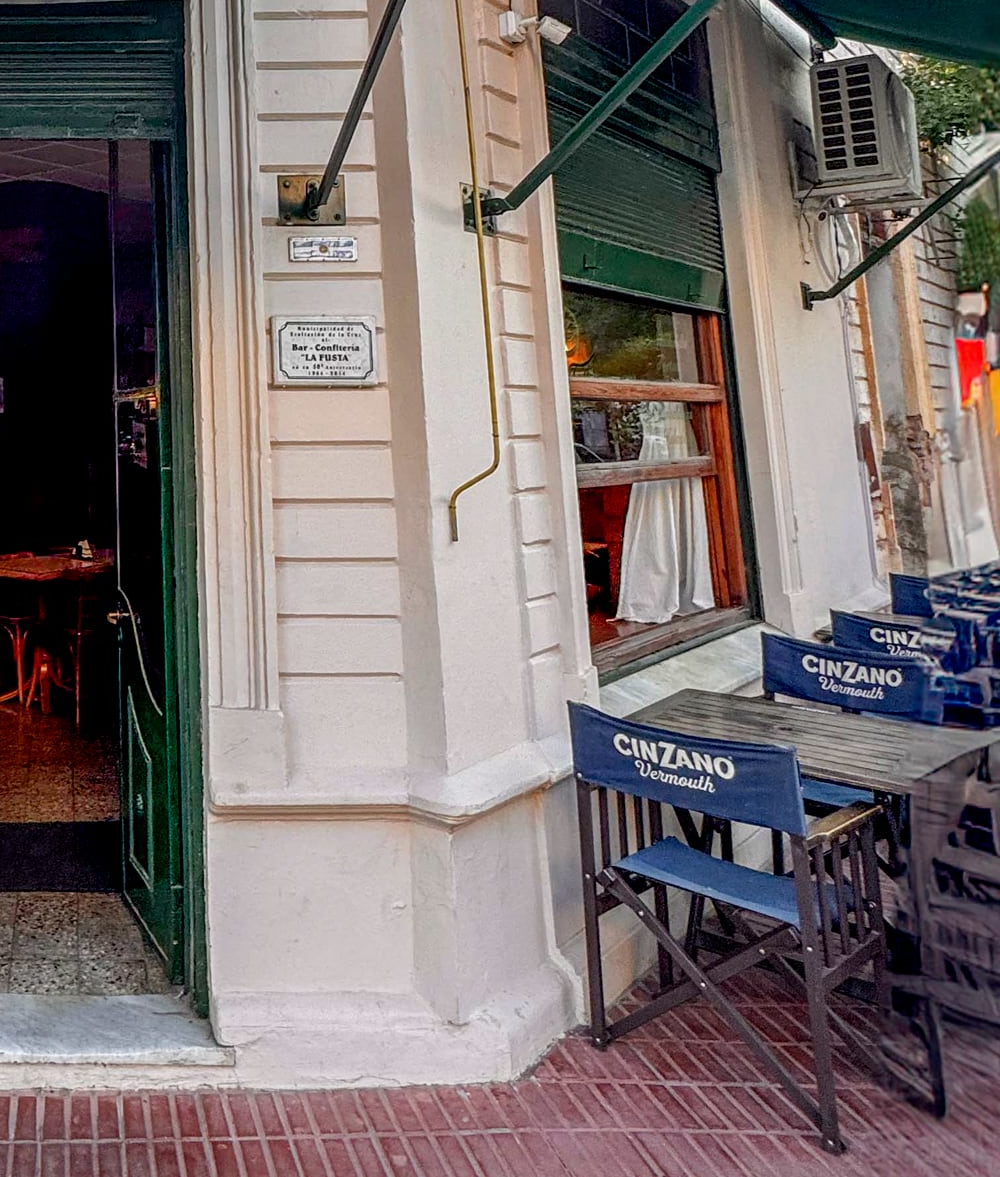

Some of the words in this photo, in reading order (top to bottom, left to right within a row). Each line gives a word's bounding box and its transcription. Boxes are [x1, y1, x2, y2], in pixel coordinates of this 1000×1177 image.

[870, 628, 922, 649] CINZ
[887, 645, 921, 657] Verm
[802, 654, 903, 687] CINZANO
[818, 676, 885, 700] Vermouth
[613, 733, 735, 780] CINZANO
[634, 759, 716, 794] Vermouth
